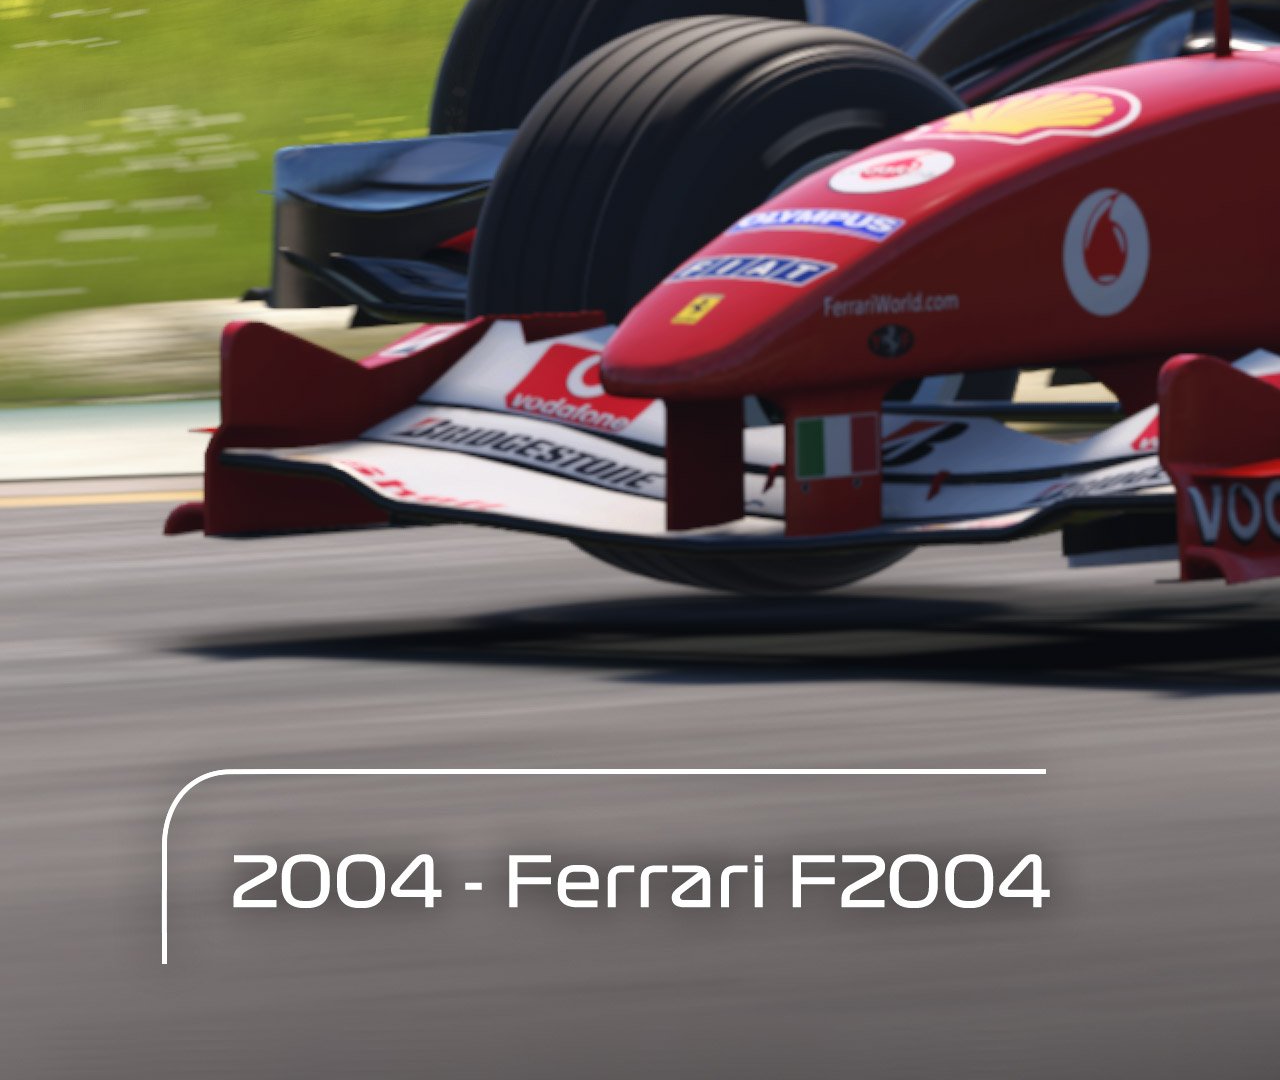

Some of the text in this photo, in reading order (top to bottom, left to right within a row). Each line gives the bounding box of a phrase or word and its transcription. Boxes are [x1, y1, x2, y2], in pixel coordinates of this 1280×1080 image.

[737, 210, 894, 234] OLYMPUS
[680, 257, 822, 281] FIAT
[823, 292, 960, 317] FerrariWorld.com
[512, 392, 630, 432] vodafone
[399, 416, 664, 490] BRIDGESTONE
